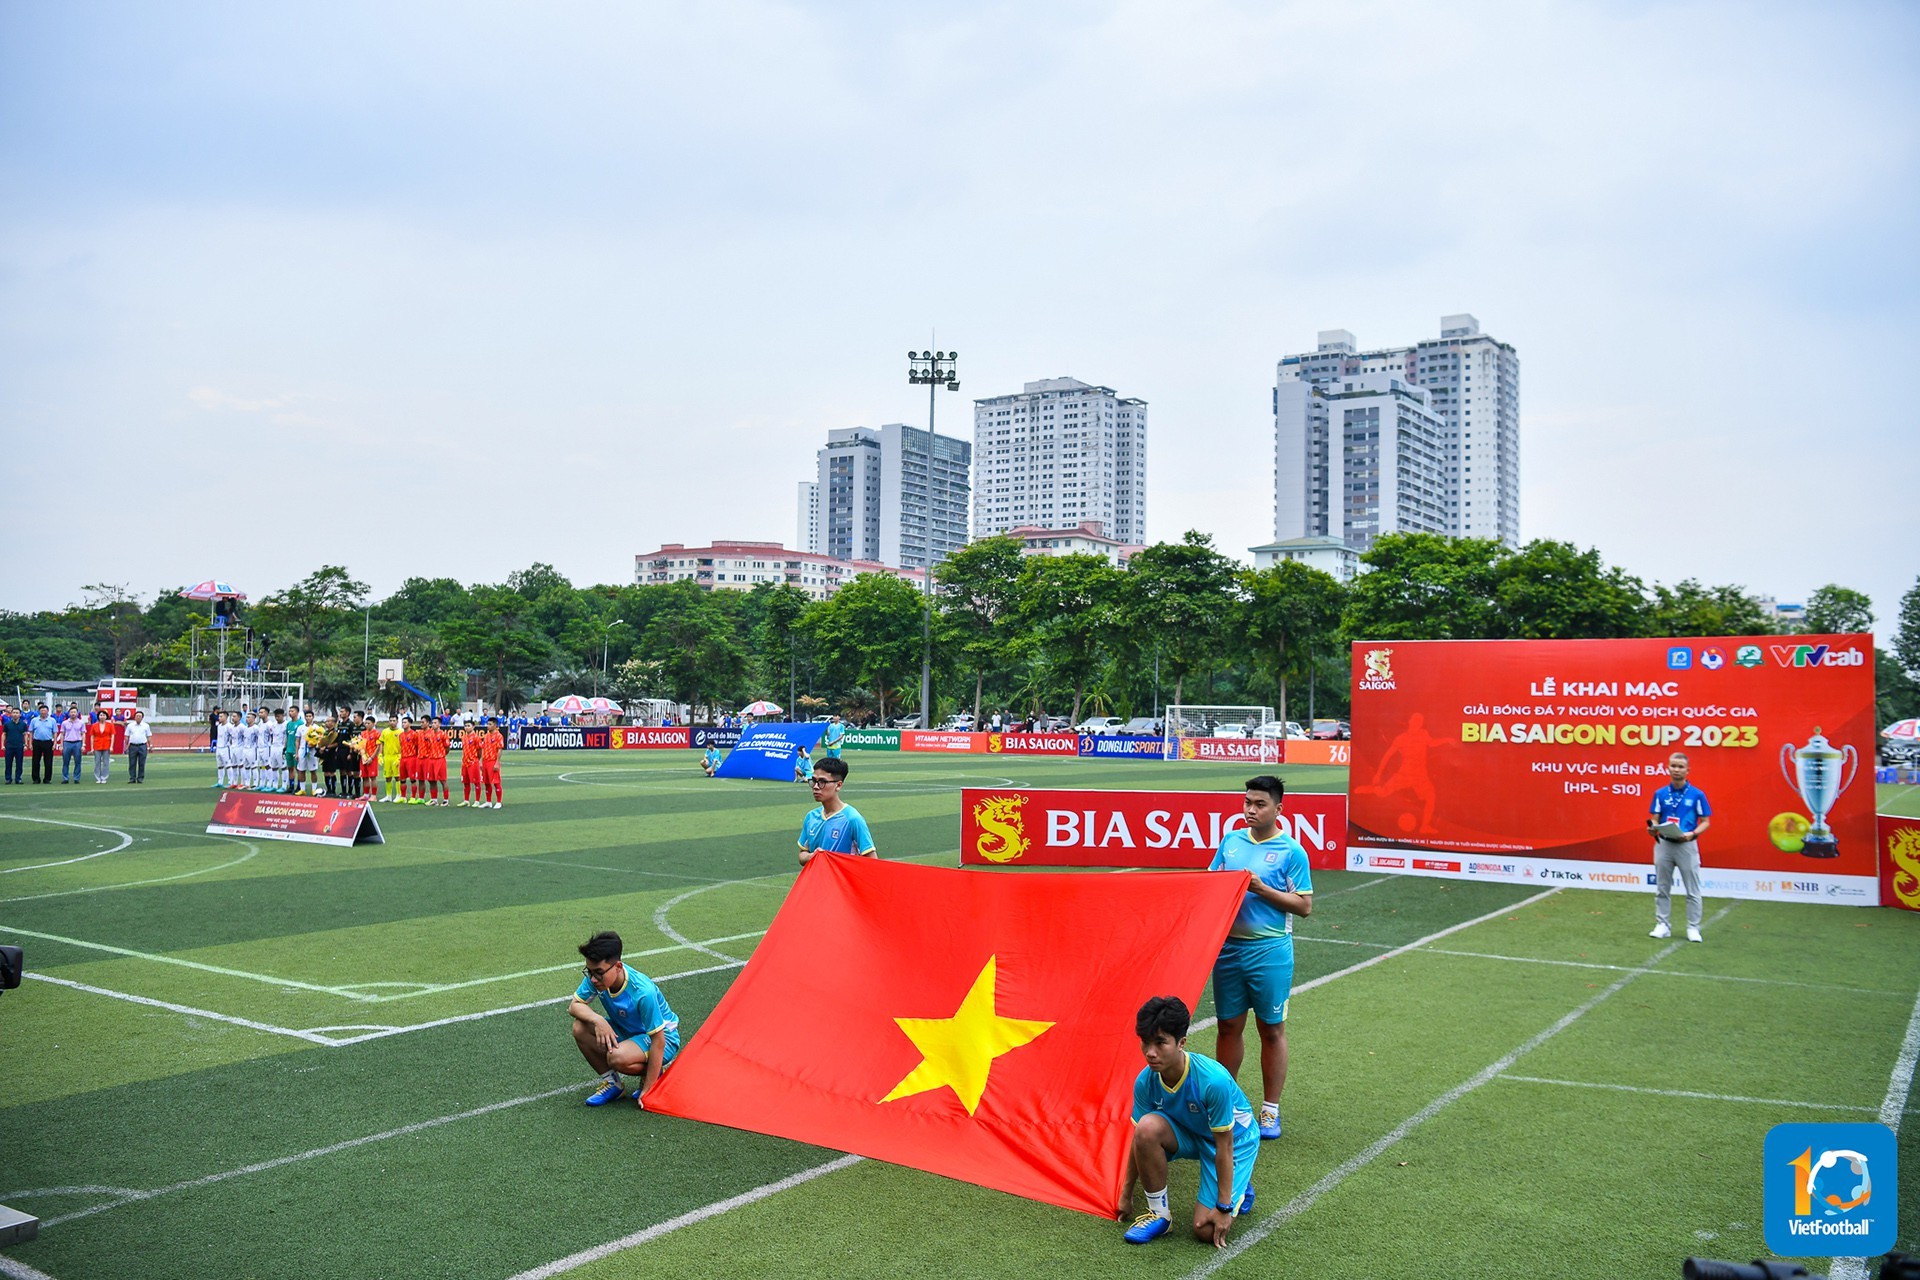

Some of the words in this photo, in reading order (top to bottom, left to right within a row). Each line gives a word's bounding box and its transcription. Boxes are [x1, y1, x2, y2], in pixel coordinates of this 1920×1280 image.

[1770, 645, 1864, 667] VTVcab
[1359, 682, 1395, 690] SAIGON
[1531, 677, 1556, 696] LỄ
[1562, 682, 1618, 696] KHAI
[1625, 682, 1679, 700] MẠC
[1463, 703, 1489, 715] GIẢI
[1492, 704, 1531, 715] BÓNG
[1534, 704, 1554, 716] ĐÁ
[1557, 707, 1565, 716] 7
[1569, 705, 1614, 716] NGƯỜI
[1618, 705, 1639, 716] VÔ
[1642, 707, 1678, 718] ĐỊCH
[1681, 705, 1726, 718] QUỐC
[1730, 707, 1758, 717] GIA
[524, 733, 606, 748] AOBONGDA.NET
[627, 732, 647, 744] BIA
[648, 732, 686, 744] SAIGON
[1462, 722, 1508, 742] BIA
[1510, 723, 1616, 745] SAIGON
[1620, 725, 1681, 746] CUP
[1683, 725, 1759, 748] 2023
[751, 741, 796, 749] COMMUNITY
[1005, 738, 1027, 749] BIA
[1029, 738, 1073, 750] SAIGON
[1200, 744, 1226, 756] BIA
[1531, 762, 1562, 773] KHU
[1566, 762, 1598, 775] VỰC
[1601, 762, 1640, 775] MIỀN
[1645, 762, 1670, 776] BẮ
[1564, 781, 1599, 794] [HPL
[1612, 784, 1641, 796] S10]
[288, 808, 301, 816] CUP
[300, 809, 316, 818] 2023
[1046, 810, 1135, 848] BIA
[1468, 862, 1515, 873] AOBONGDA.NET
[1551, 870, 1583, 881] TikTok
[1588, 872, 1640, 884] vitamin
[1794, 881, 1819, 892] SHB
